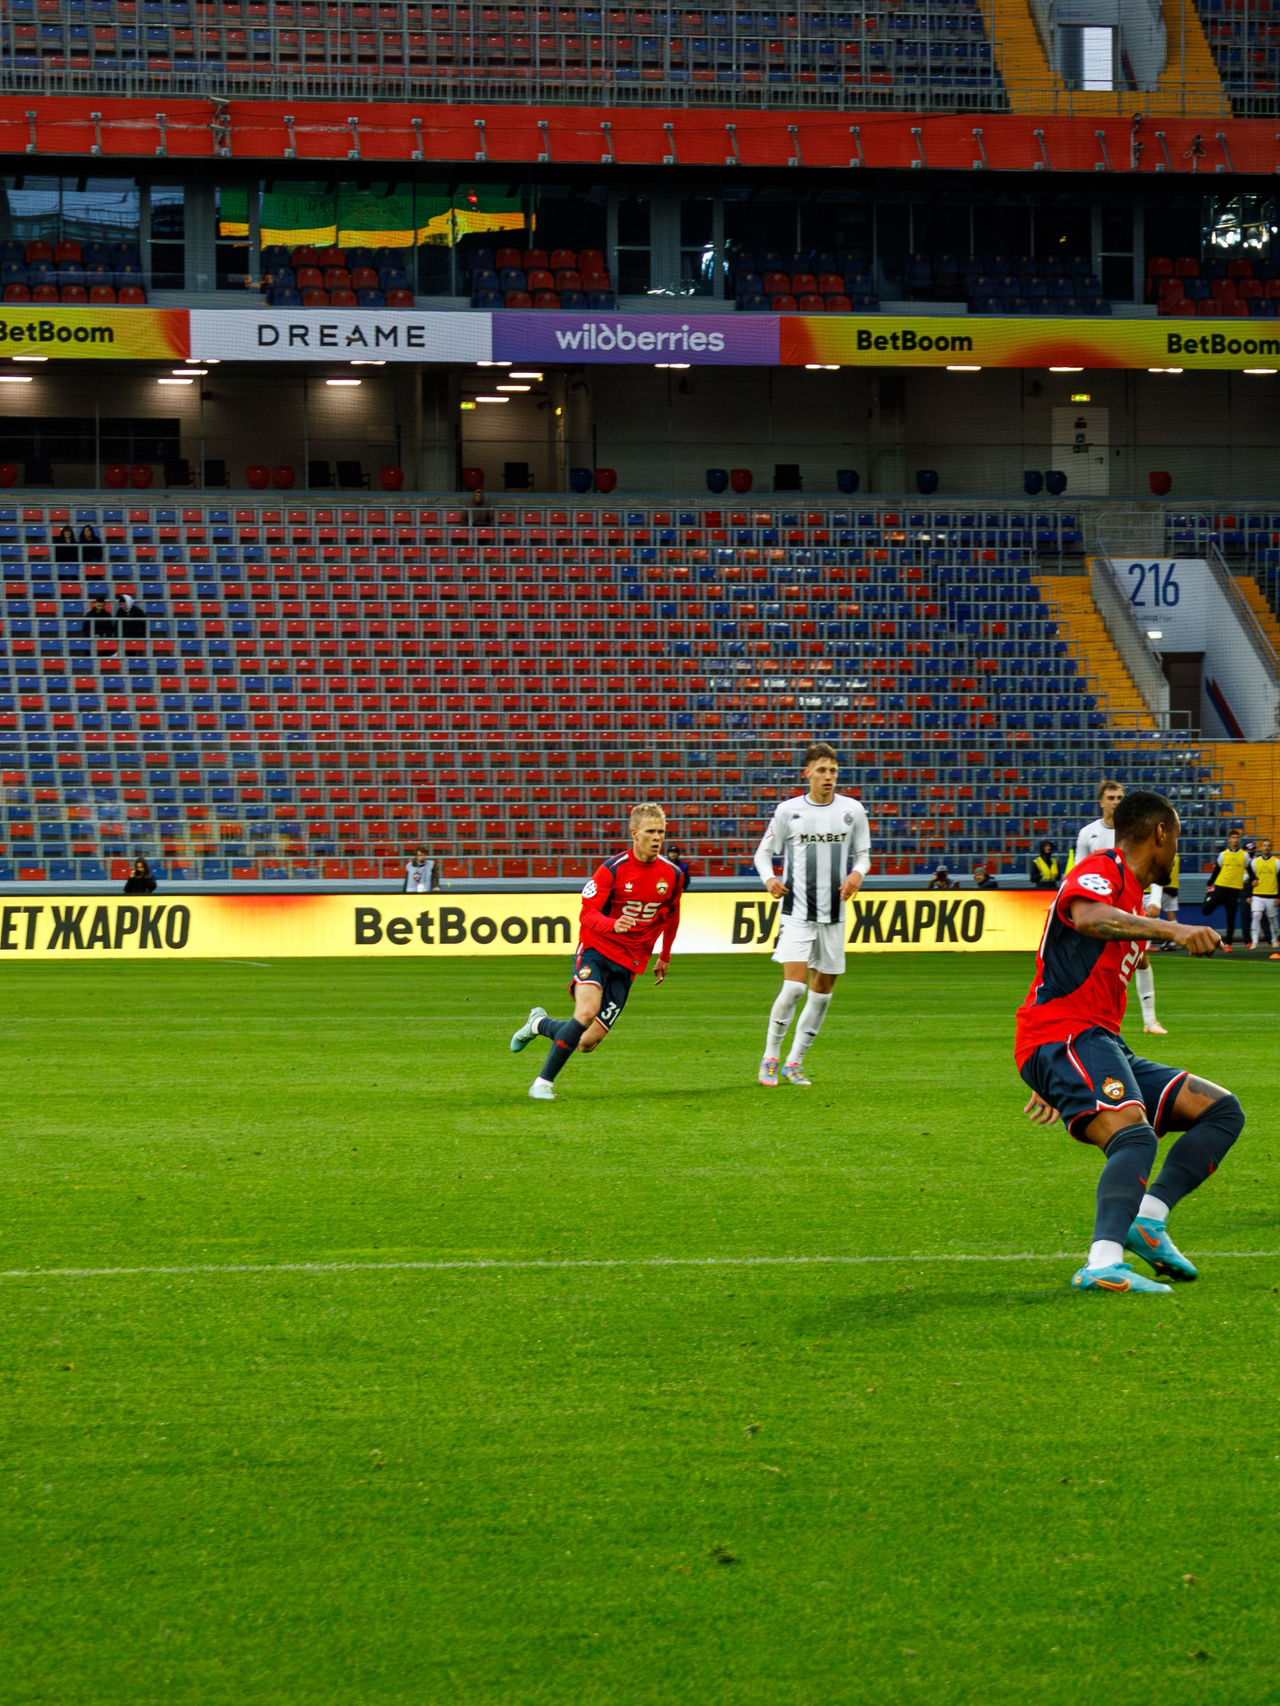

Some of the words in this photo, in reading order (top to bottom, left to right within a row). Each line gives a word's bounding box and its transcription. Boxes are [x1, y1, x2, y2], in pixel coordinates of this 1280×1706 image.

[257, 324, 426, 347] DREAME
[555, 323, 725, 351] wildberries
[857, 329, 973, 351] BetBoom
[1167, 333, 1280, 355] BetBoom
[1127, 562, 1180, 607] 216
[46, 904, 191, 950] ЖАРКО
[355, 906, 572, 945] BetBoom
[848, 899, 985, 943] ЖАРКО
[601, 1001, 620, 1026] 31
